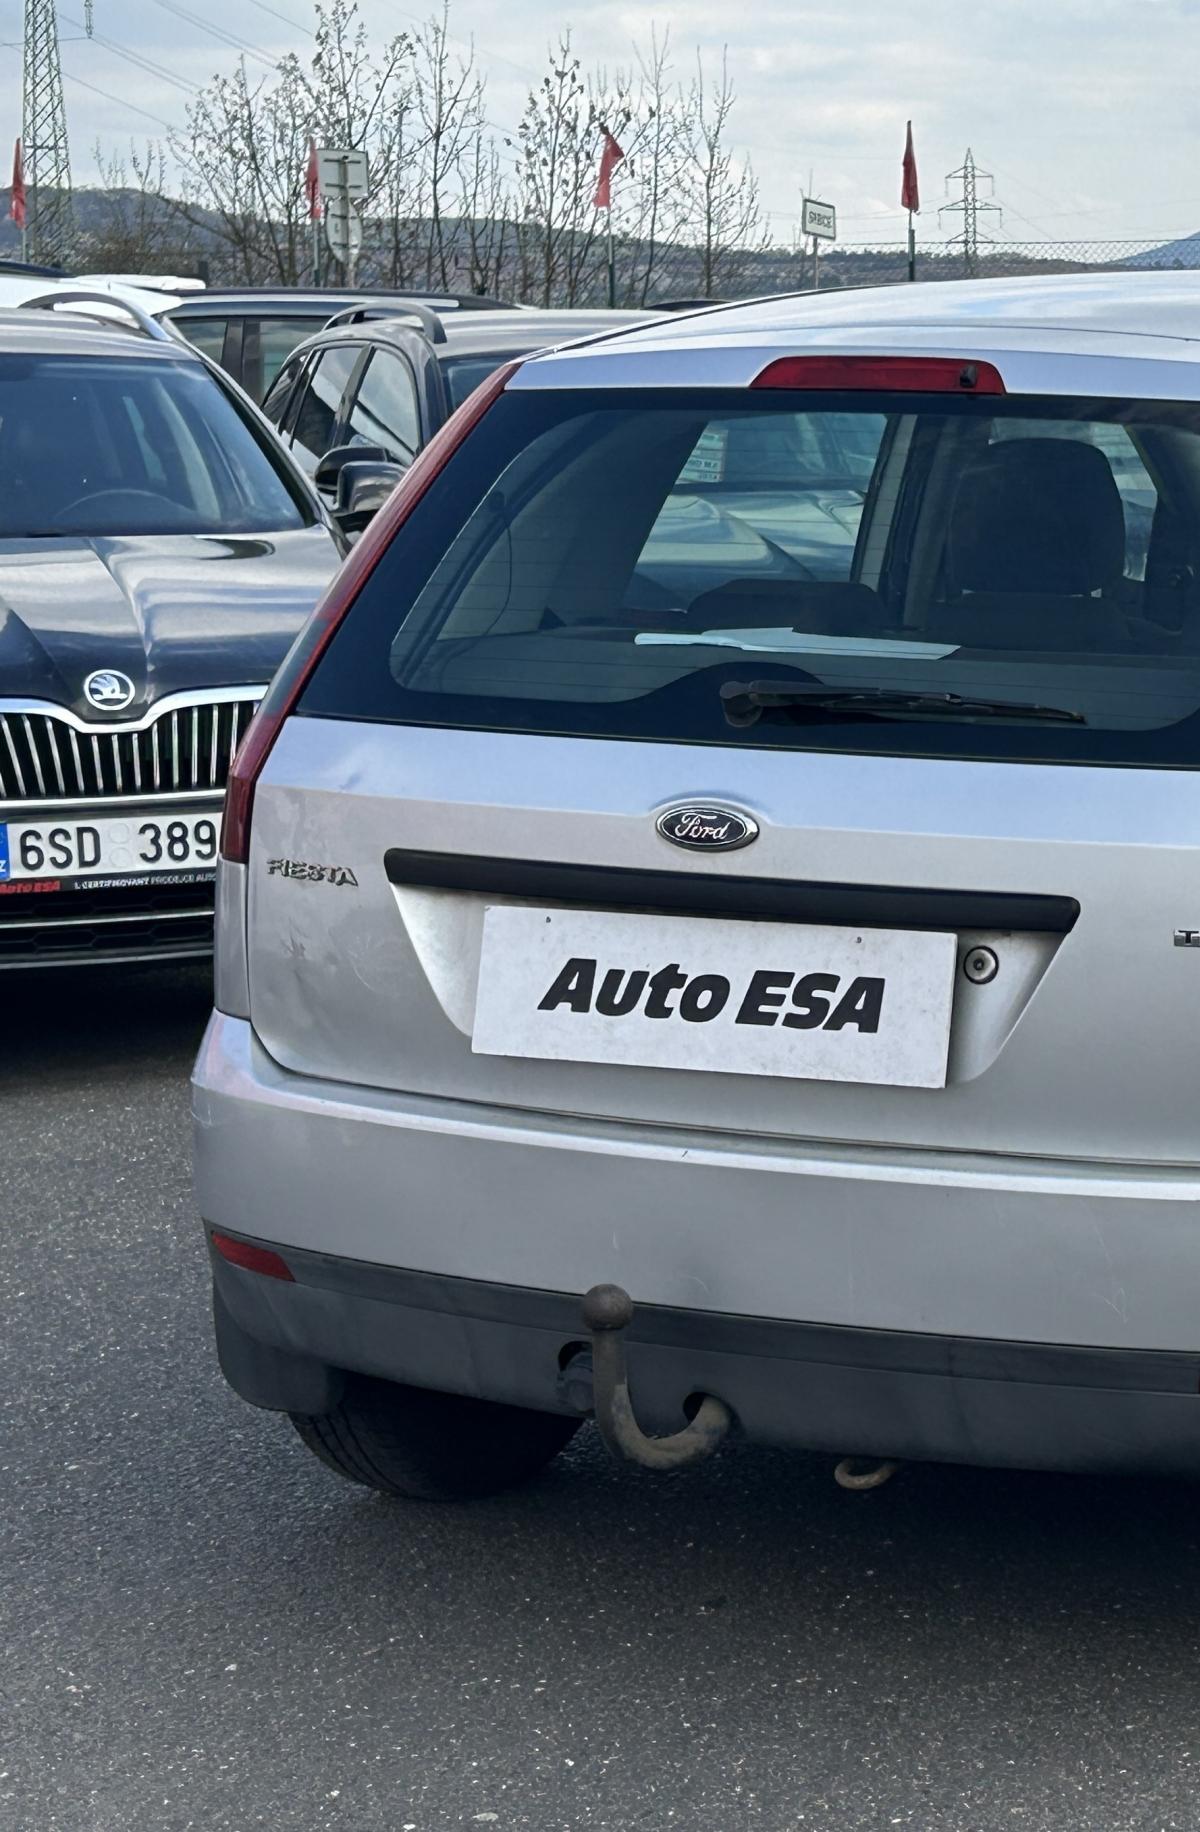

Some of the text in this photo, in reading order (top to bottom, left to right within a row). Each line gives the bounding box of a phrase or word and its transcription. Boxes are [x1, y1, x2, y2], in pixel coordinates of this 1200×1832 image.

[675, 812, 731, 840] Ford
[20, 826, 101, 871] 6SD
[266, 859, 359, 887] FIESTA
[537, 957, 886, 1034] Auto ESA
